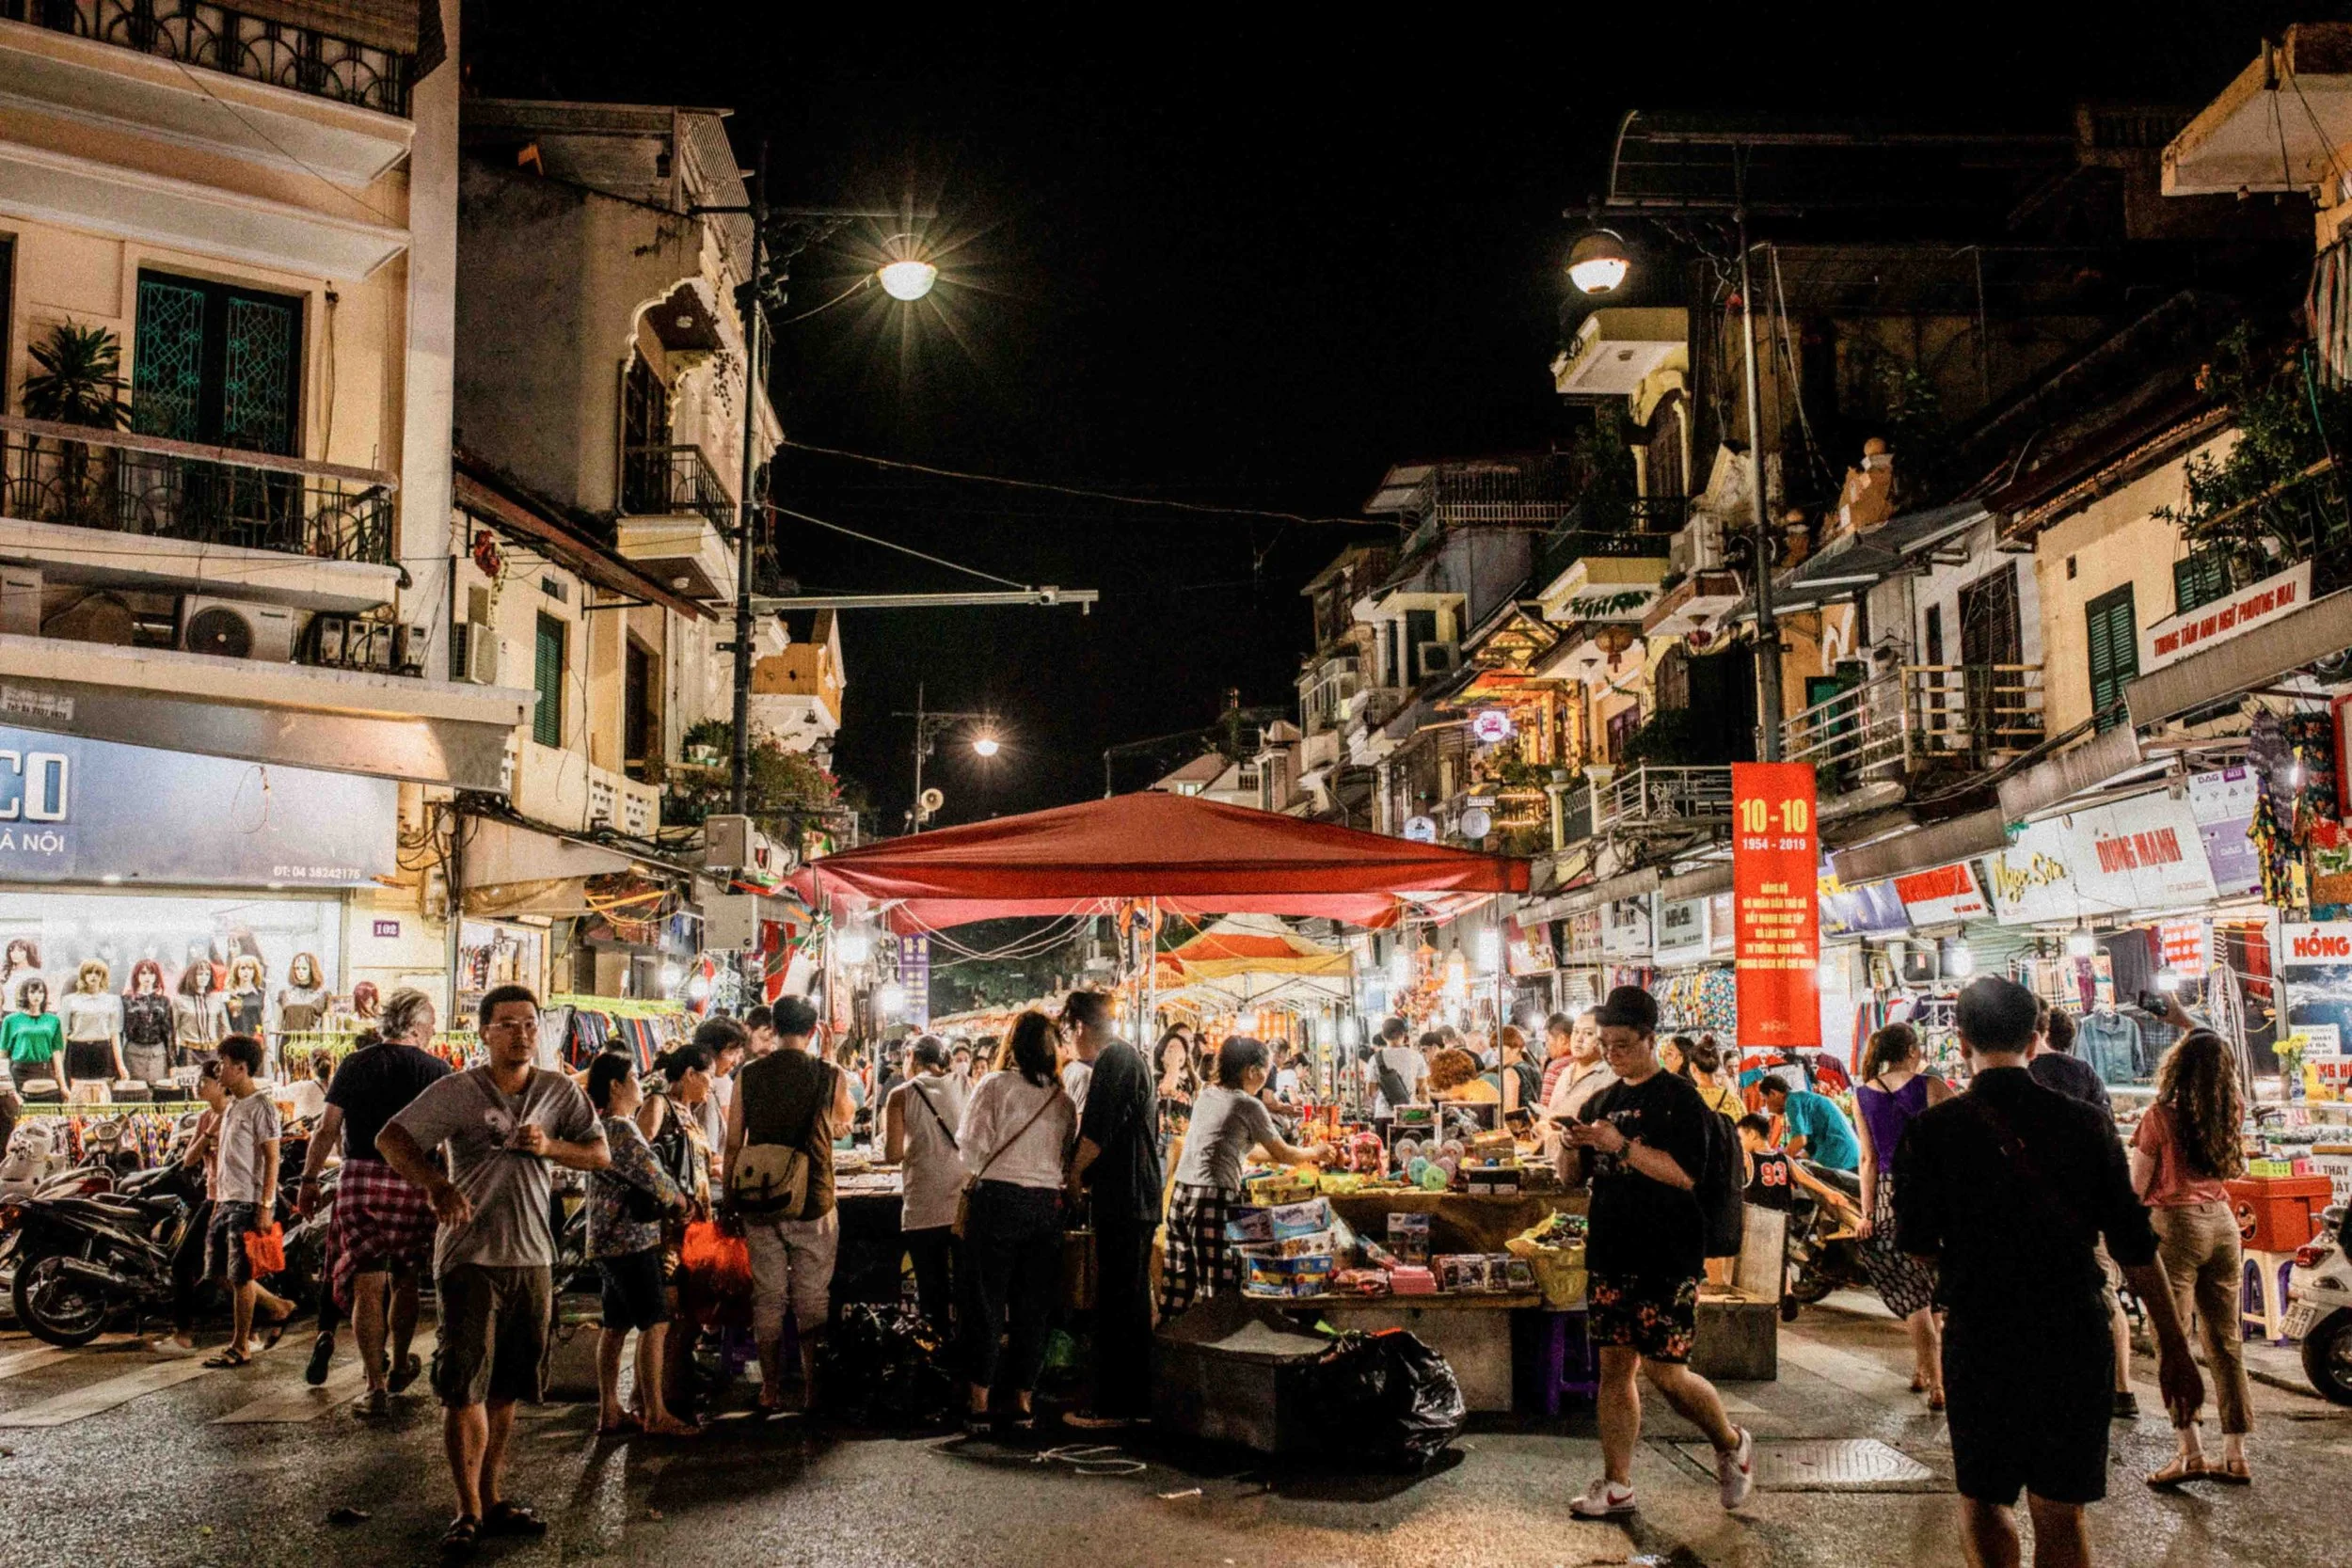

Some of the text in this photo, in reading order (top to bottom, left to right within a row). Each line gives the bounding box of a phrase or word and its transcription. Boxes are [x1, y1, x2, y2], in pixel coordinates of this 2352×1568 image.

[23, 830, 64, 857] NỘI
[1742, 837, 1769, 850] 1954
[1779, 837, 1805, 850] 2019
[376, 924, 397, 935] 102
[1761, 1161, 1787, 1186] 93
[2323, 1165, 2348, 1176] THAY
